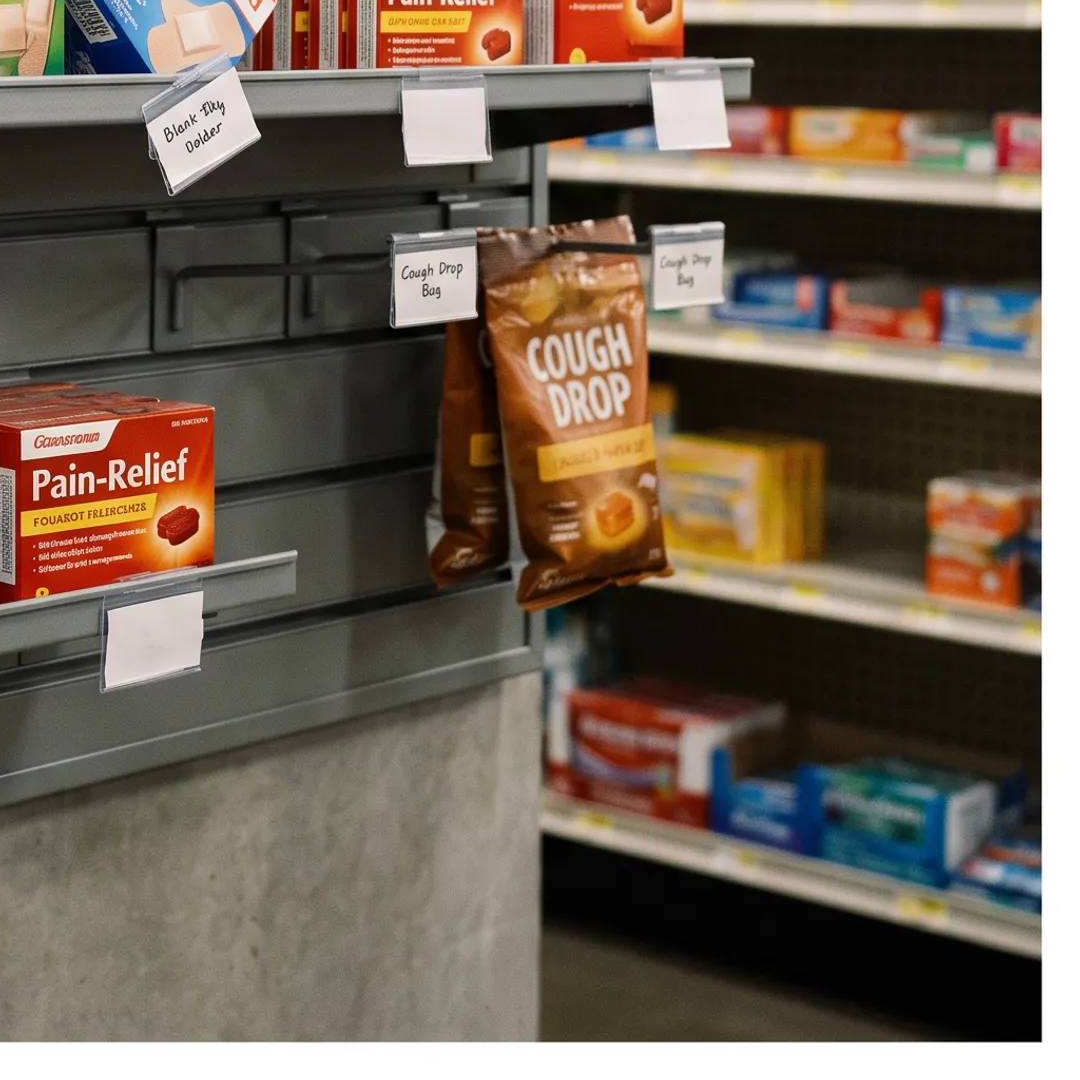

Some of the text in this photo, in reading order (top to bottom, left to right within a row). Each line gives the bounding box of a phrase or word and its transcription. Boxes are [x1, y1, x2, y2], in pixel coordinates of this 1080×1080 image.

[163, 113, 198, 143] Blank
[401, 261, 464, 282] Cough Drop
[422, 283, 442, 299] Bag
[526, 323, 633, 383] COUGH
[547, 371, 632, 428] DROP
[32, 447, 189, 502] Pain-Relief
